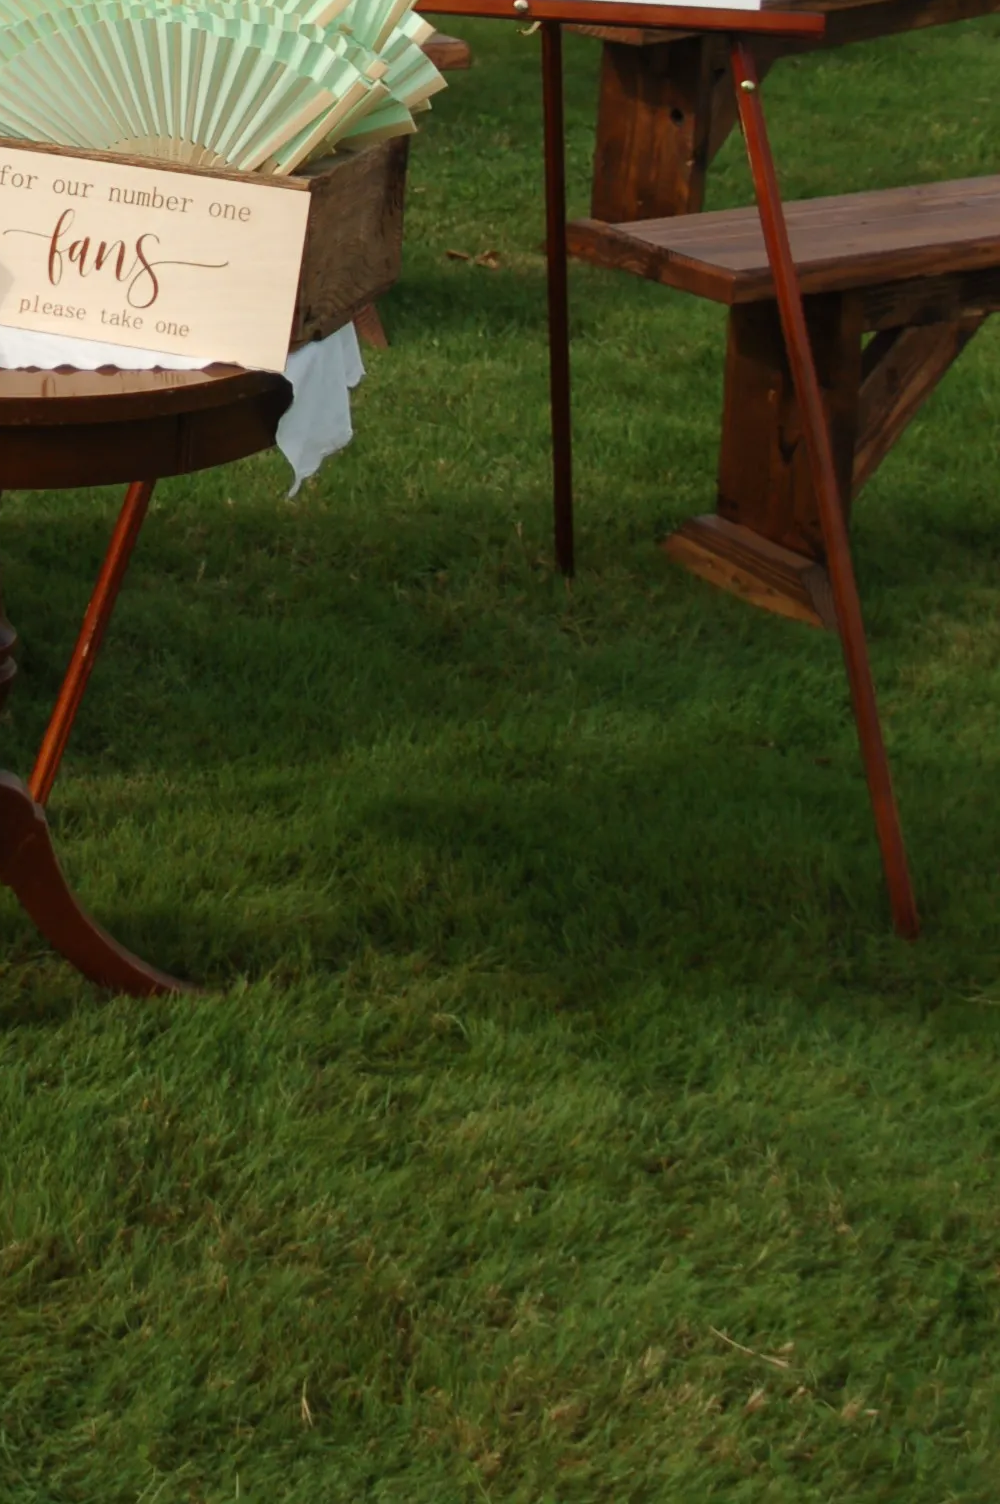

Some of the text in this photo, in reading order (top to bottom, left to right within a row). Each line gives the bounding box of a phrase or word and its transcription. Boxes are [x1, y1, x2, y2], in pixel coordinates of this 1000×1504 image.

[51, 179, 95, 199] our
[107, 186, 194, 214] number
[208, 202, 252, 223] one
[3, 208, 229, 309] fans
[18, 295, 191, 338] please take one
